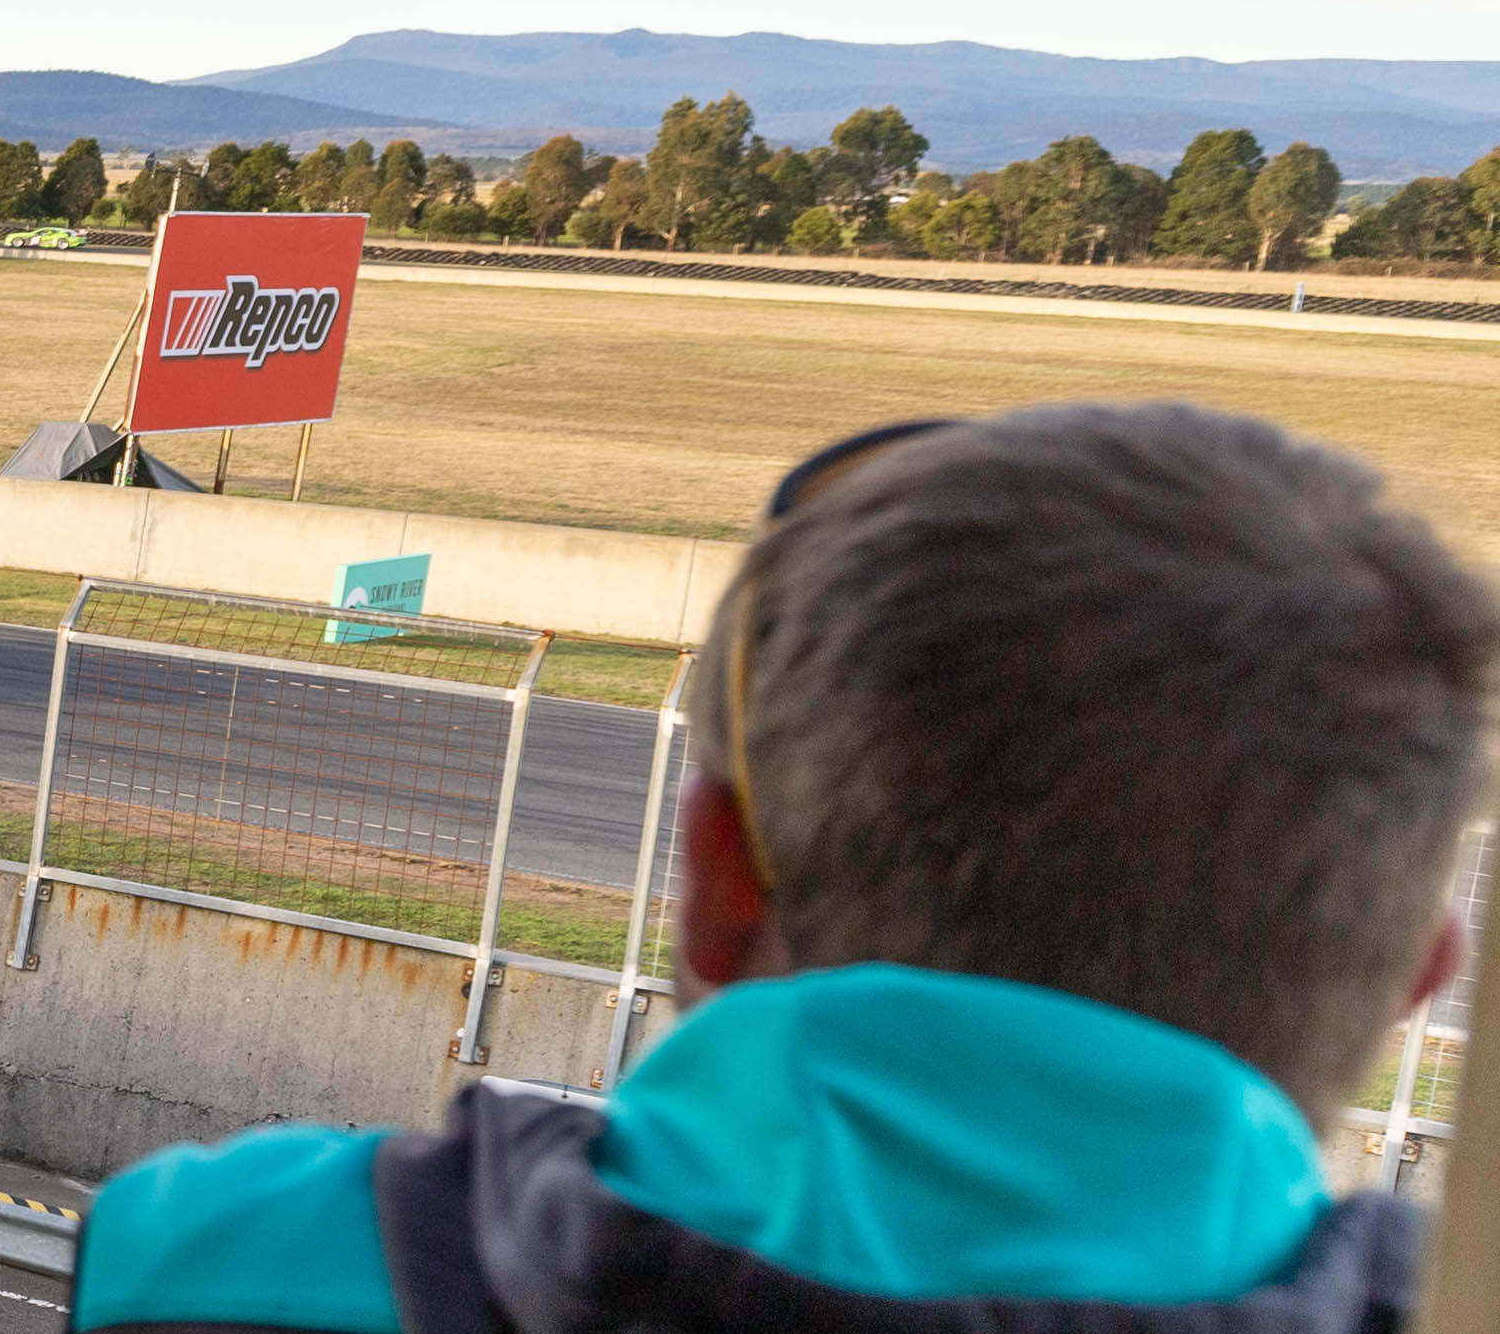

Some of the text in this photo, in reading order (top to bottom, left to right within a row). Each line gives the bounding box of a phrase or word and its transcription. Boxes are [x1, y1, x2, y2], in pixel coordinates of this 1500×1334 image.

[205, 277, 339, 366] Repco
[370, 578, 424, 604] SNOWY RIVER
